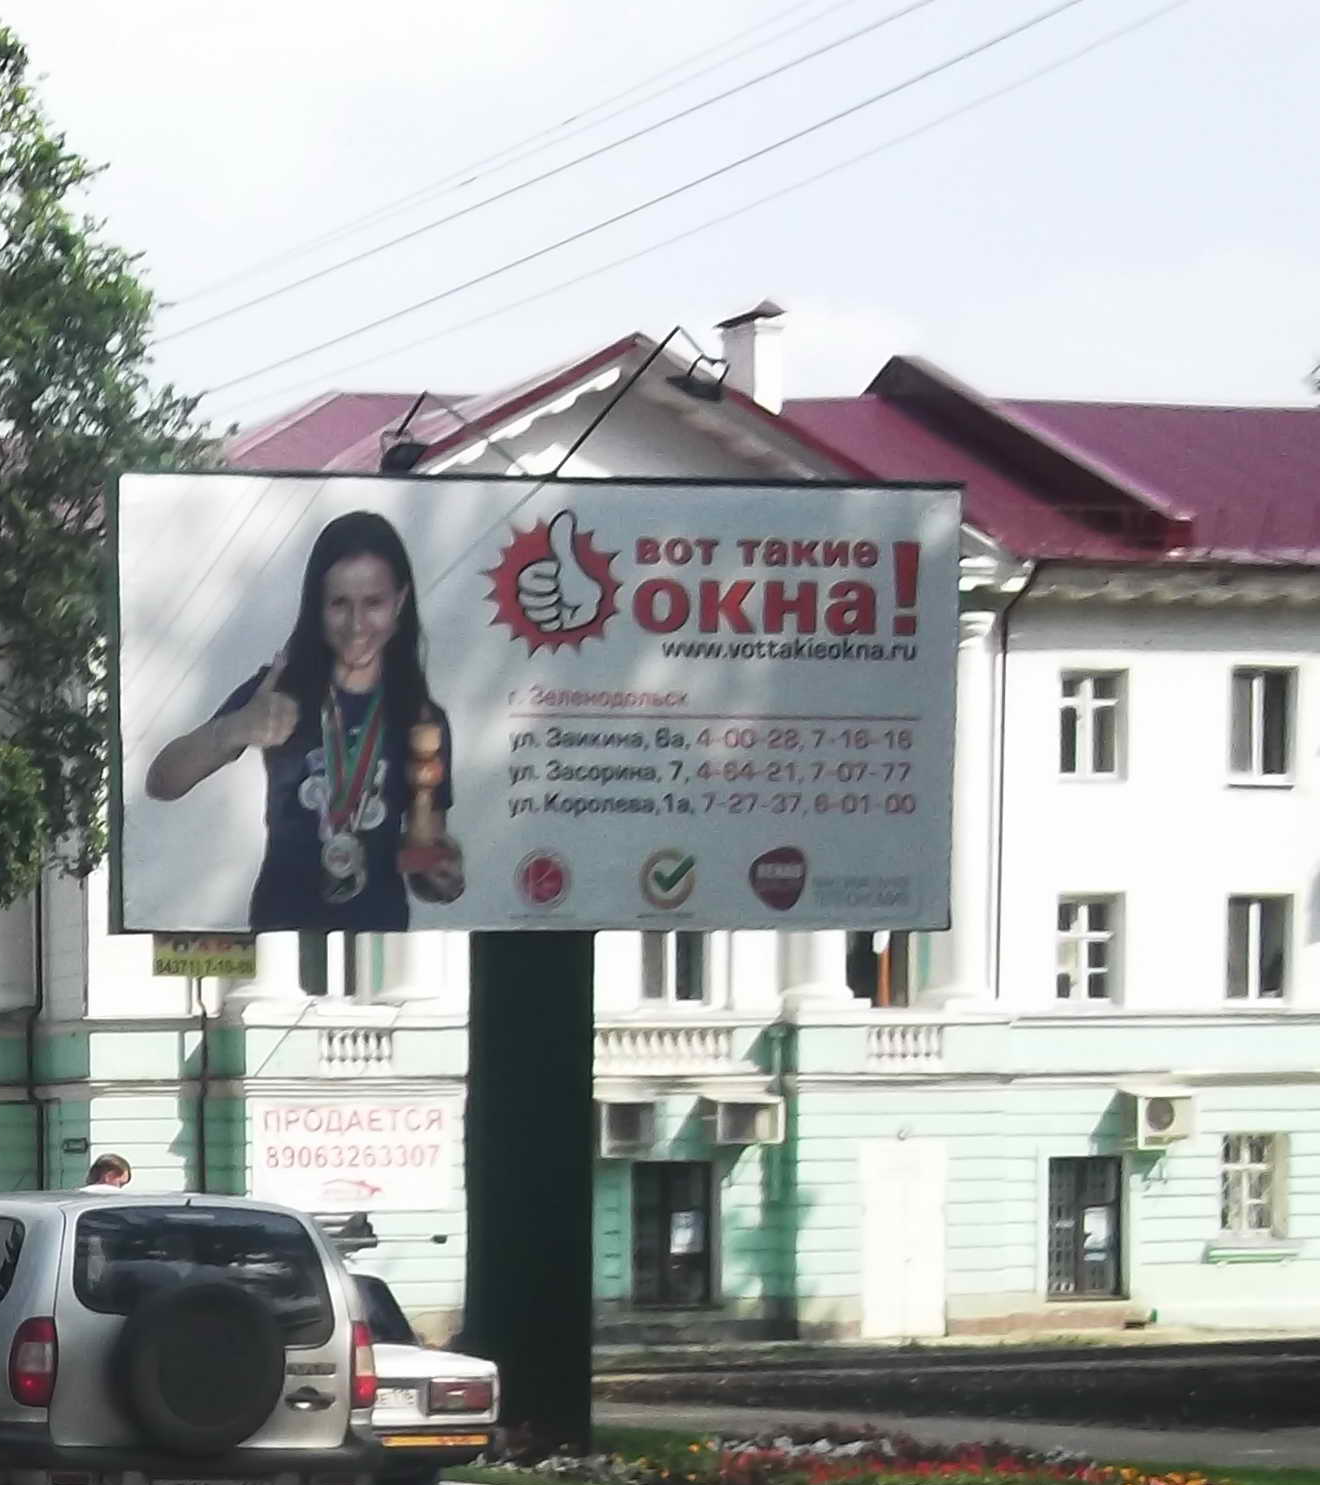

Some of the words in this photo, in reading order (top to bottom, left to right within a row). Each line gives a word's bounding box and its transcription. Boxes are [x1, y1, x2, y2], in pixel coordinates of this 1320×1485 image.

[662, 638, 918, 661] www.vottakieokna.ru
[811, 761, 912, 783] 7-07-77
[263, 1108, 444, 1132] ПРОДАЕТСЯ
[266, 1145, 441, 1168] 89063263307
